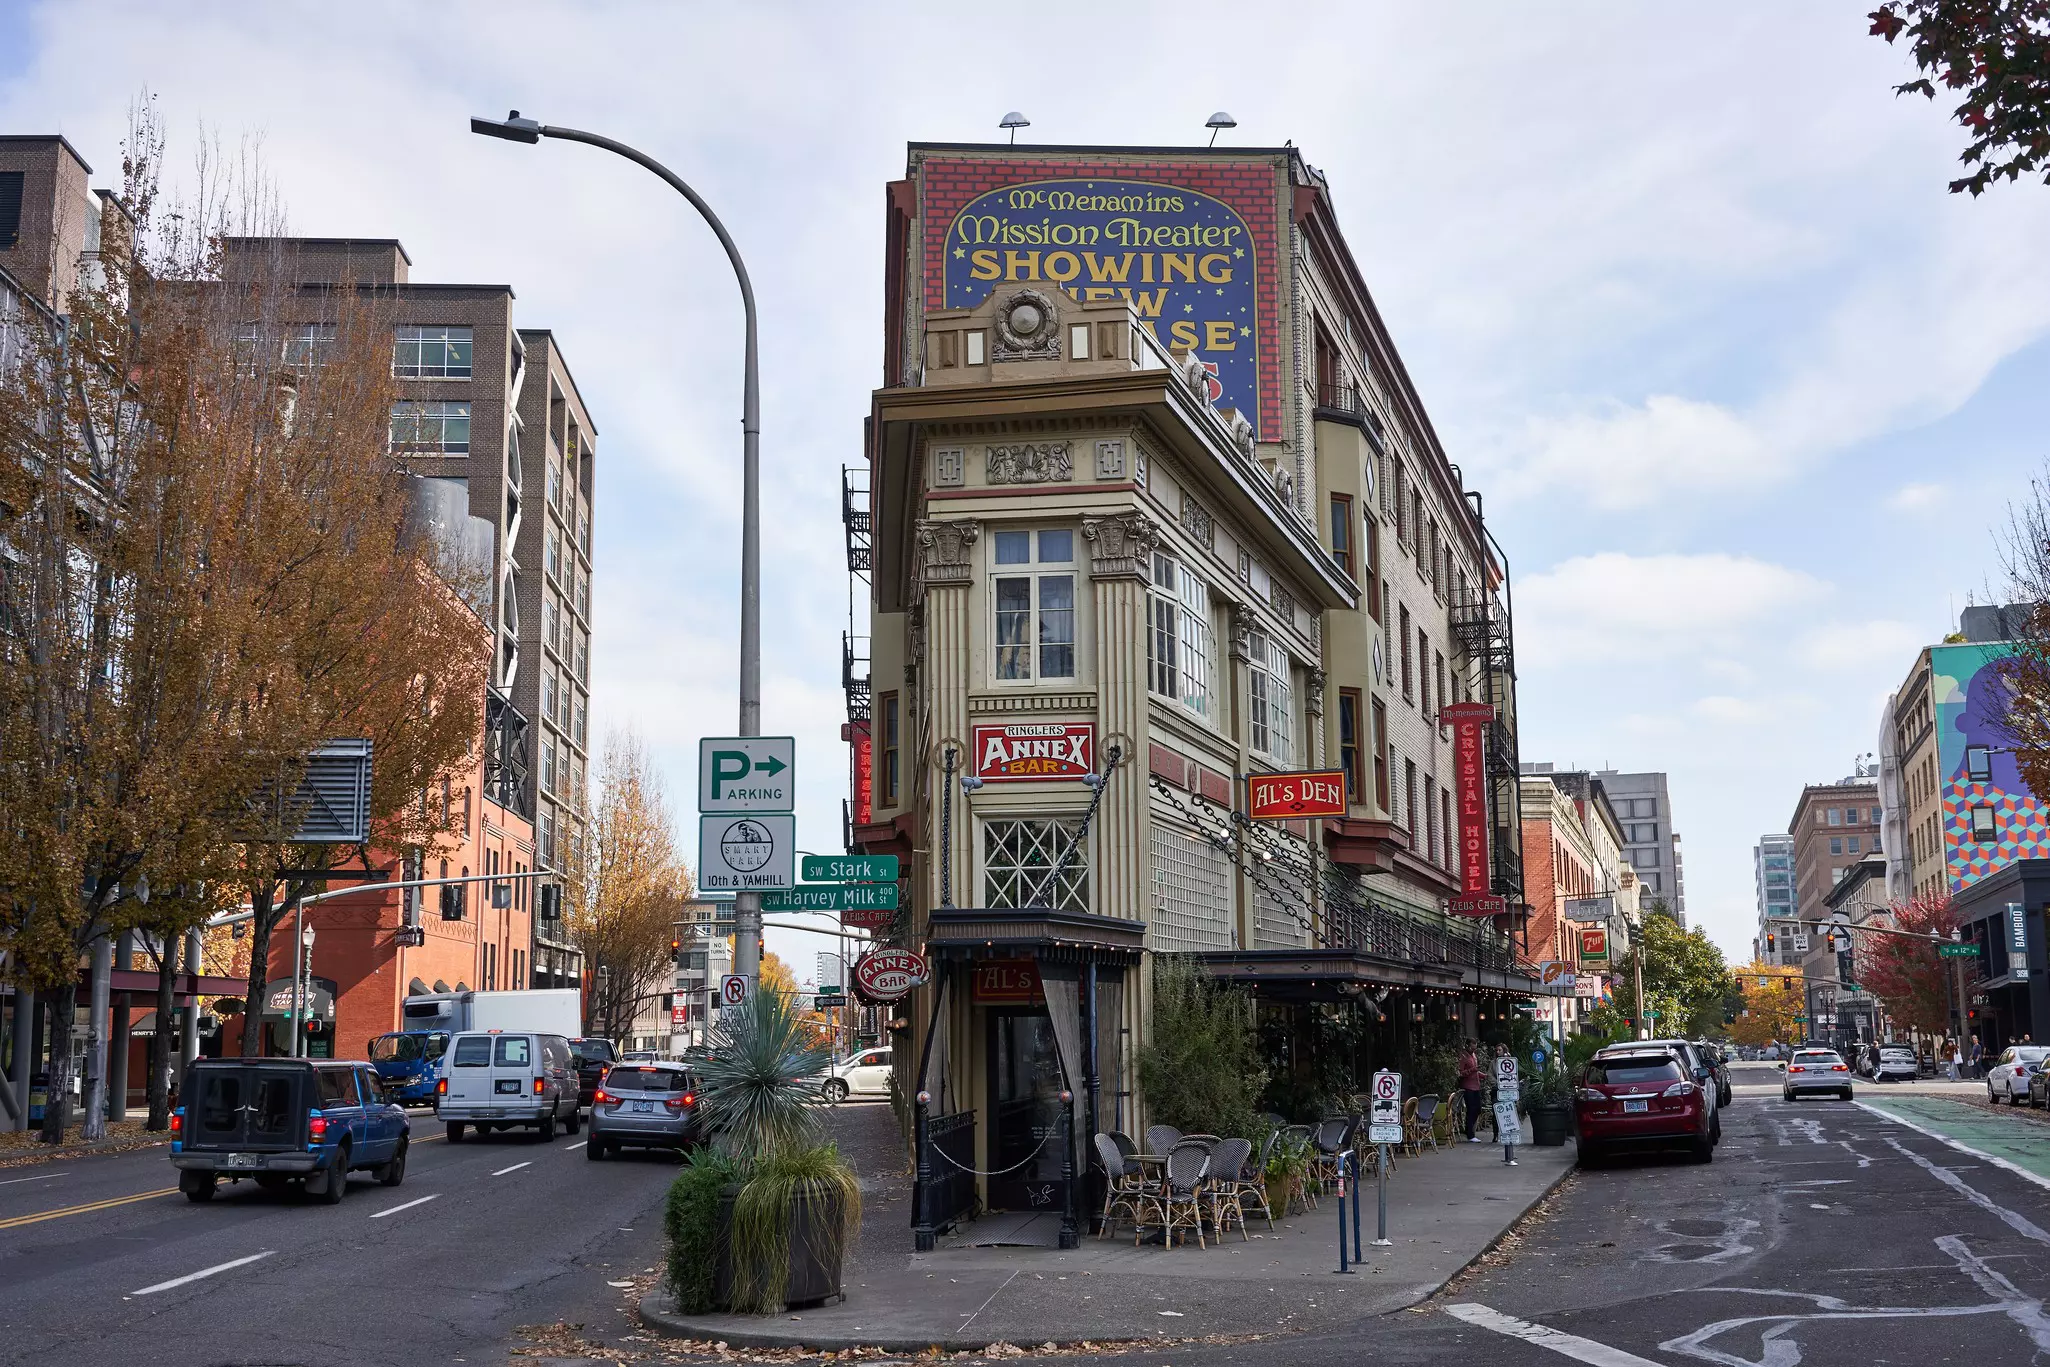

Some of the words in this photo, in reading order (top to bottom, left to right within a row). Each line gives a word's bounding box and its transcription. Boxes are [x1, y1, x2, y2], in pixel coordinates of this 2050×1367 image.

[1009, 189, 1185, 213] McMenamins
[957, 214, 1099, 245] Mission
[1104, 217, 1242, 248] Theater
[969, 249, 1234, 284] SHOWING
[1007, 725, 1065, 736] RINGLERS
[980, 735, 1089, 772] ANNEX
[1009, 759, 1059, 774] BAR
[1461, 723, 1478, 815] CRYSTAL
[1255, 783, 1295, 808] AL'S
[1300, 778, 1341, 805] DEN
[725, 845, 769, 855] SMART
[729, 856, 763, 866] PARK
[1465, 825, 1482, 891] HOTEL
[809, 866, 824, 877] SW
[829, 860, 872, 877] Stark
[879, 868, 887, 877] St
[708, 875, 728, 886] 10th
[732, 874, 739, 886] &
[742, 874, 785, 886] YAMHILL
[766, 895, 780, 905] SW
[783, 889, 837, 909] Harvey
[843, 888, 875, 905] Milk
[879, 887, 893, 896] 400
[879, 895, 887, 904] St
[1451, 901, 1475, 911] ZEUS
[2012, 910, 2026, 948] BAMBOO
[862, 957, 922, 980] ANNEX
[983, 966, 1033, 989] AL'S
[1566, 963, 1573, 972] 2
[879, 975, 907, 988] BAR
